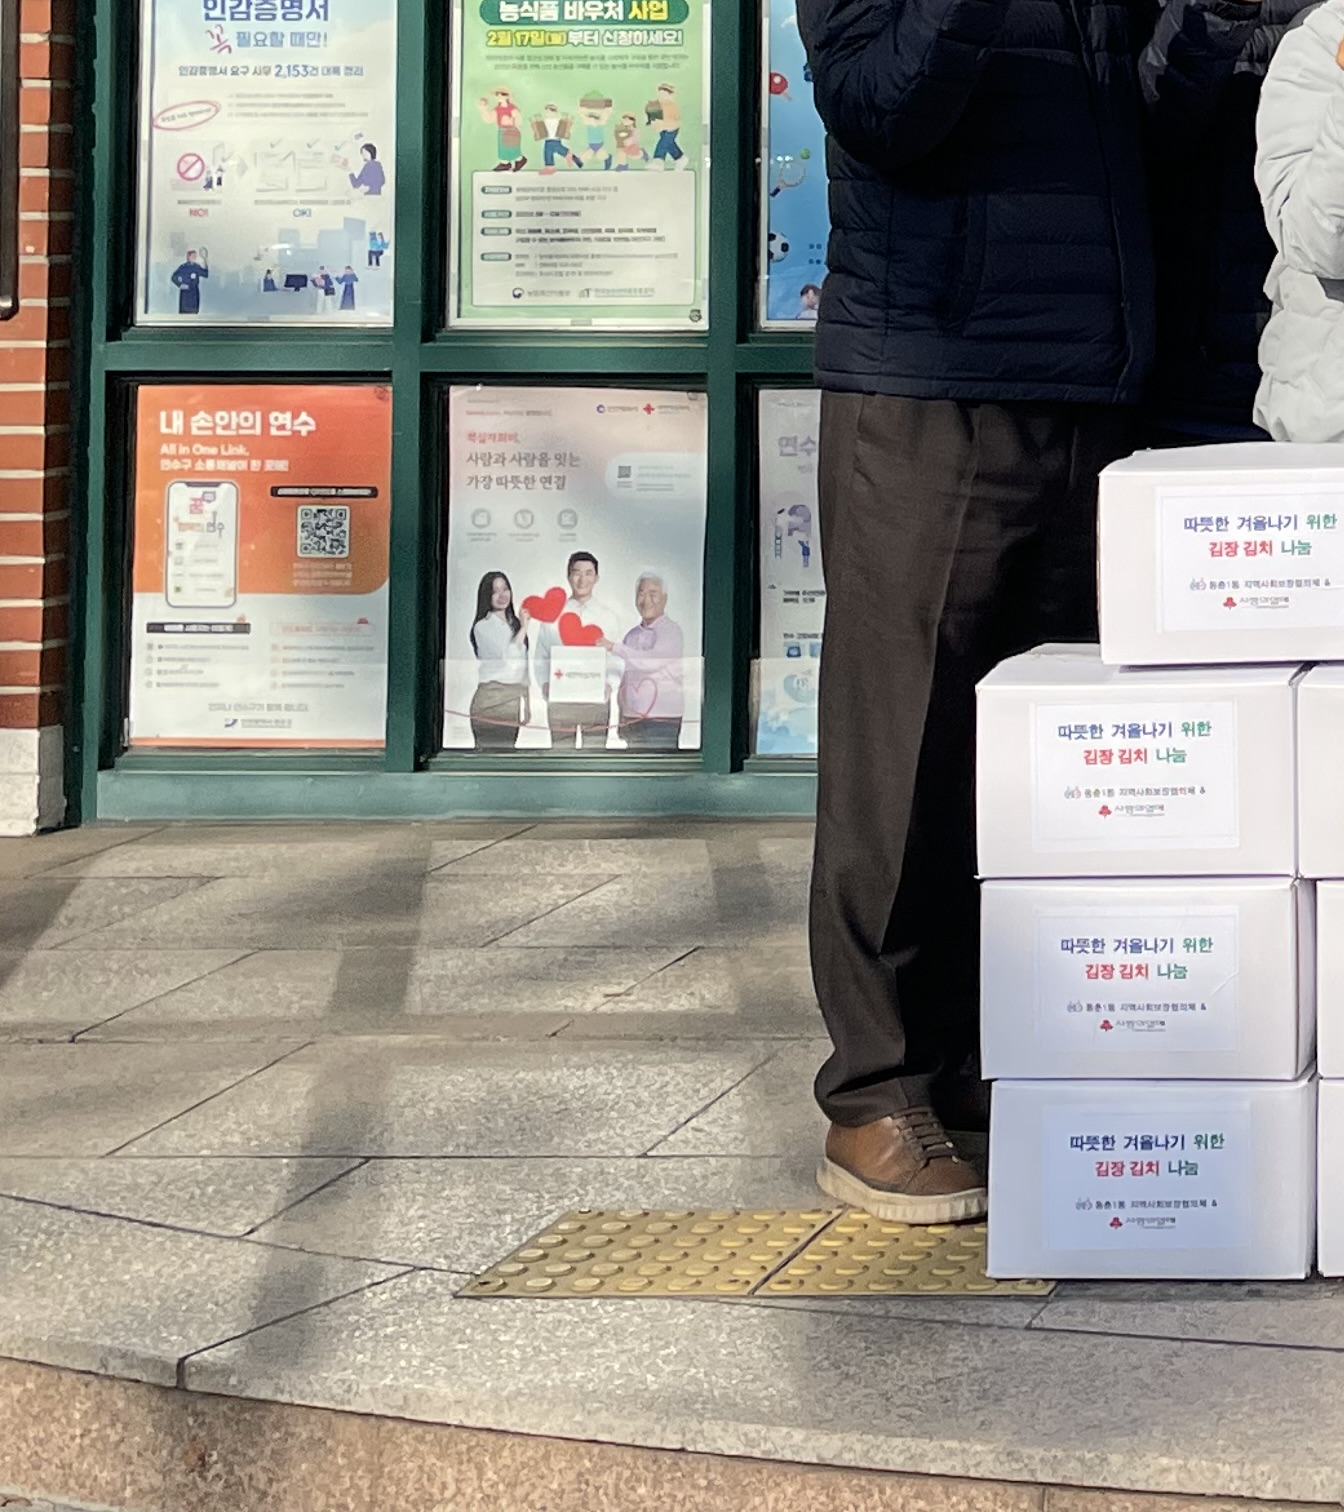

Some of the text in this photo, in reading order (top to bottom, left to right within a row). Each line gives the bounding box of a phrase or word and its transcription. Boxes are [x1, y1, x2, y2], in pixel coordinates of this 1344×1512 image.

[499, 0, 669, 22] 농식품 바우처 사업
[235, 31, 285, 48] 필요할
[160, 410, 317, 436] 내 손안의 연수
[160, 443, 177, 456] All
[178, 443, 190, 455] in
[192, 443, 218, 455] One
[466, 451, 581, 467] 사람과 사람을 잇는
[466, 474, 568, 489] 가장 따뜻한 연결
[1183, 513, 1338, 533] 따뜻한 겨울나기 위한
[1209, 539, 1312, 558] 김장 김치 나눔
[1069, 1133, 1225, 1152] 따뜻한 겨울나기 위한
[1095, 1159, 1199, 1178] 김장 김치 나눔
